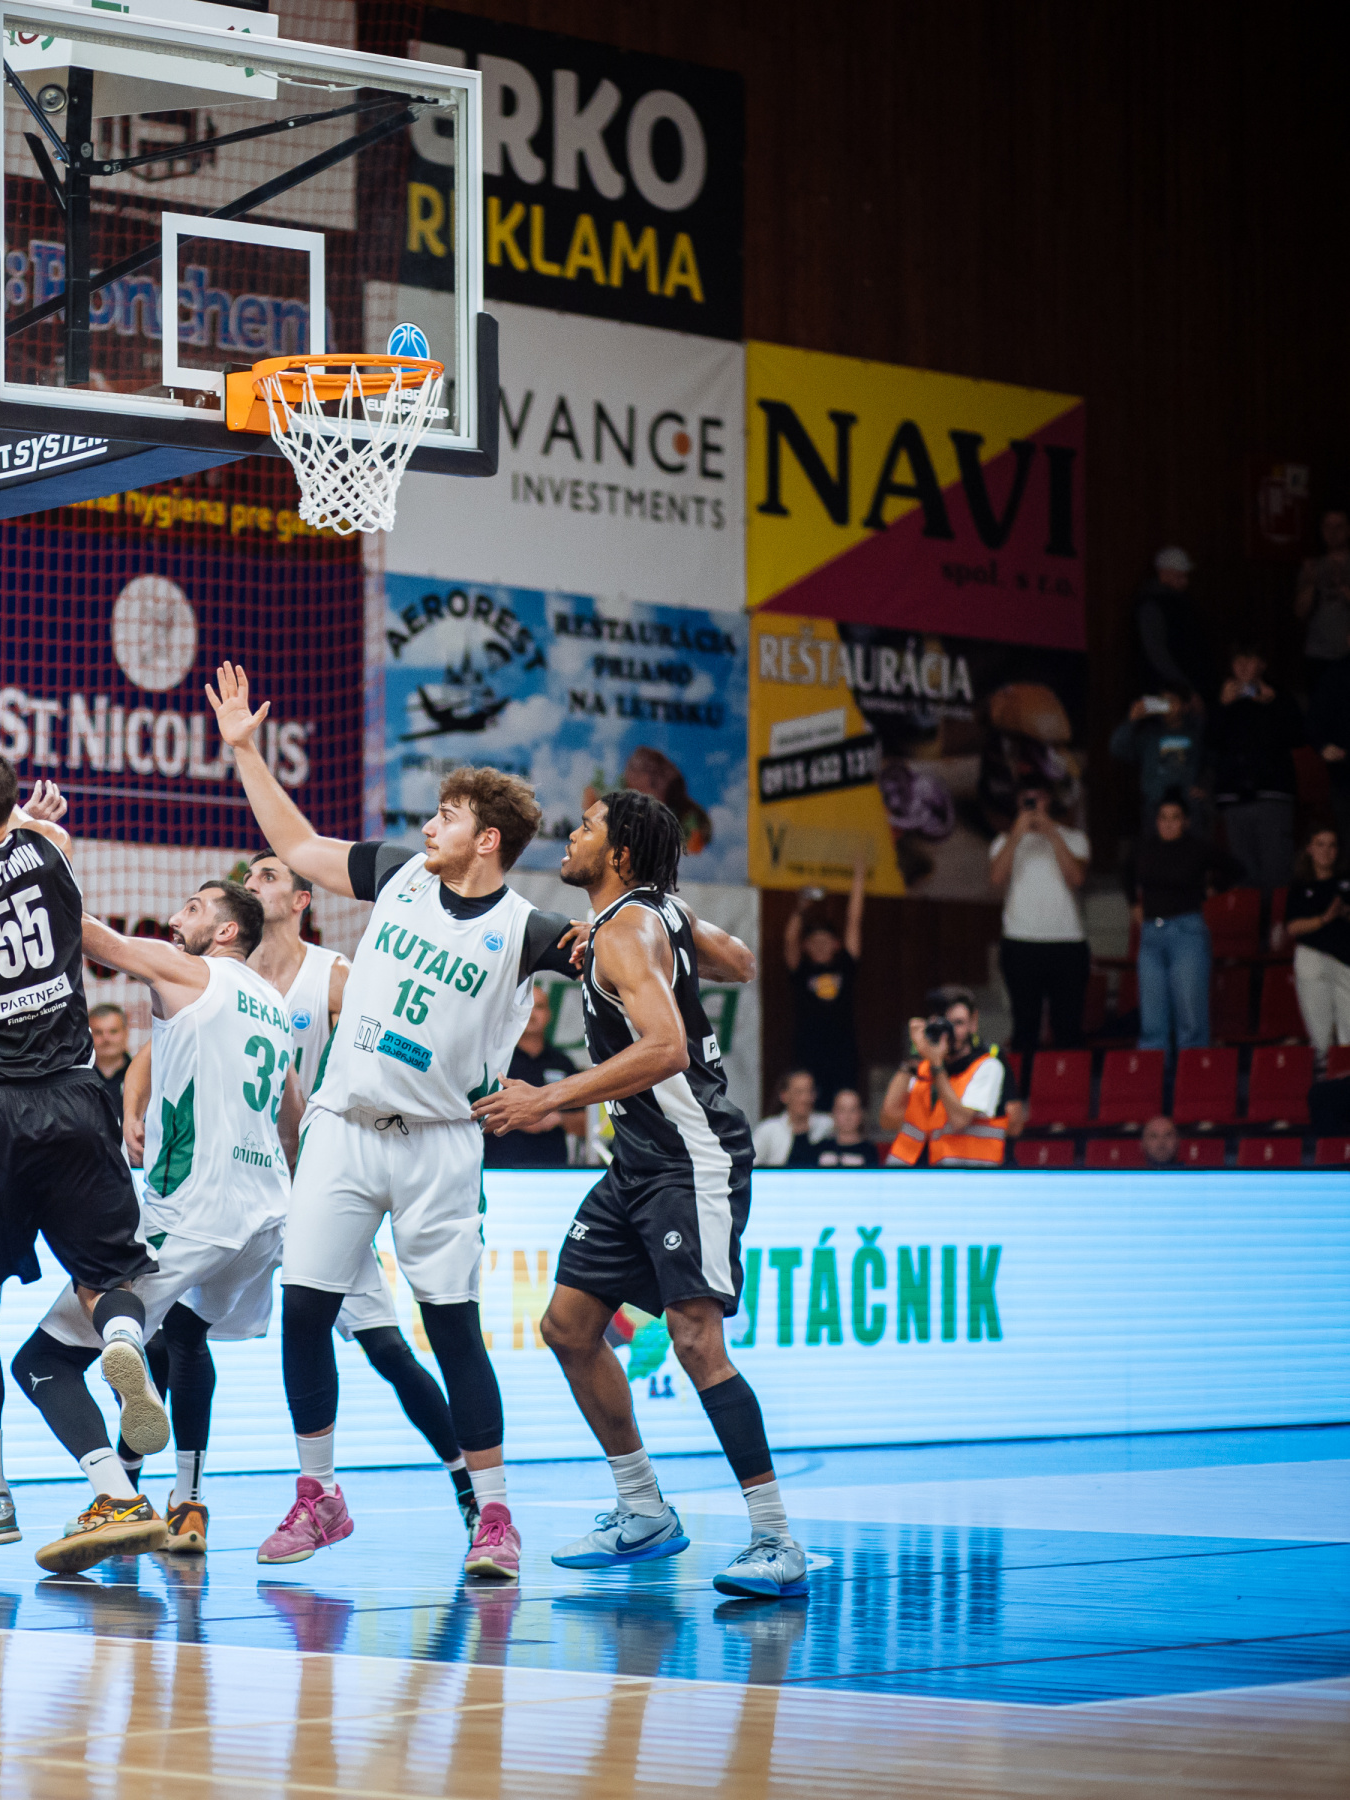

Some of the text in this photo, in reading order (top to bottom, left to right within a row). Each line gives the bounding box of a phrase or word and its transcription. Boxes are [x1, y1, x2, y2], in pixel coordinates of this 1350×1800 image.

[407, 182, 705, 303] RKLAMA
[498, 386, 726, 481] VANCE
[512, 472, 726, 530] INVESTMENTS
[756, 398, 1078, 558] NAVI
[374, 921, 489, 999] KUTAISI
[237, 990, 291, 1034] BEKAU
[392, 977, 436, 1027] 15
[233, 1145, 272, 1168] onima
